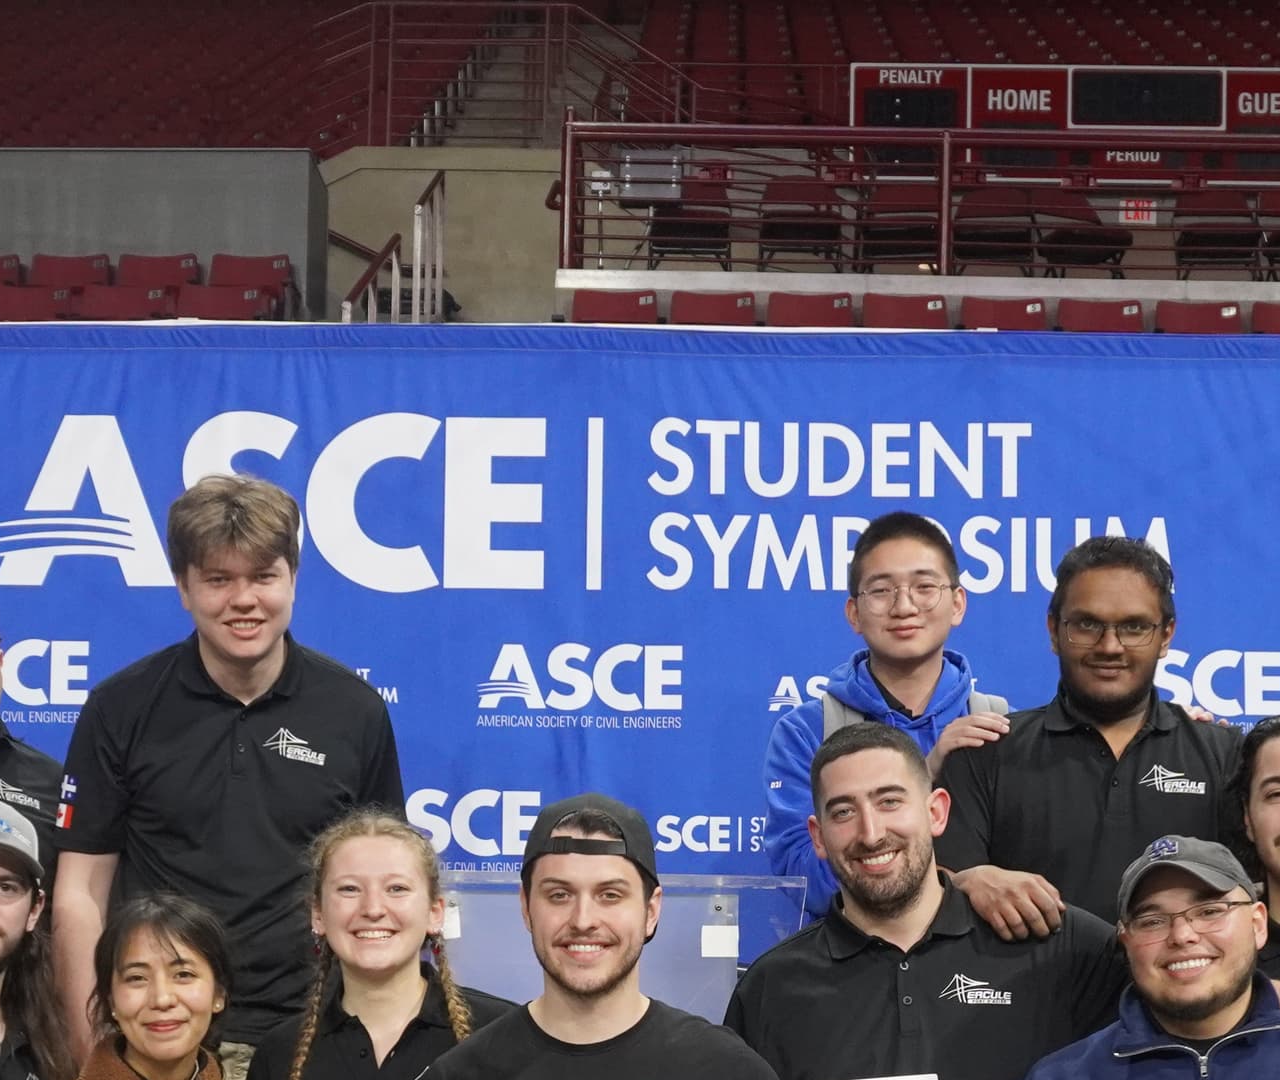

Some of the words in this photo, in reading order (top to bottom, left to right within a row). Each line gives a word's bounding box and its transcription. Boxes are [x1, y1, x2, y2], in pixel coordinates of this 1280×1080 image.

[878, 69, 943, 85] PENALTY
[987, 88, 1052, 112] HOME
[1124, 199, 1152, 221] EXIT
[647, 416, 1033, 500] STUDENT
[2, 638, 90, 706] CE
[477, 643, 683, 711] ASCE
[1, 711, 26, 723] CIVIL
[29, 711, 81, 724] ENGINEER
[477, 715, 533, 728] AMERICAN
[536, 715, 578, 728] SOCIETY
[580, 715, 594, 728] OF
[596, 716, 621, 729] CIVIL
[623, 716, 682, 729] ENGINEERS
[405, 788, 541, 857] SCE
[655, 815, 731, 853] SCE
